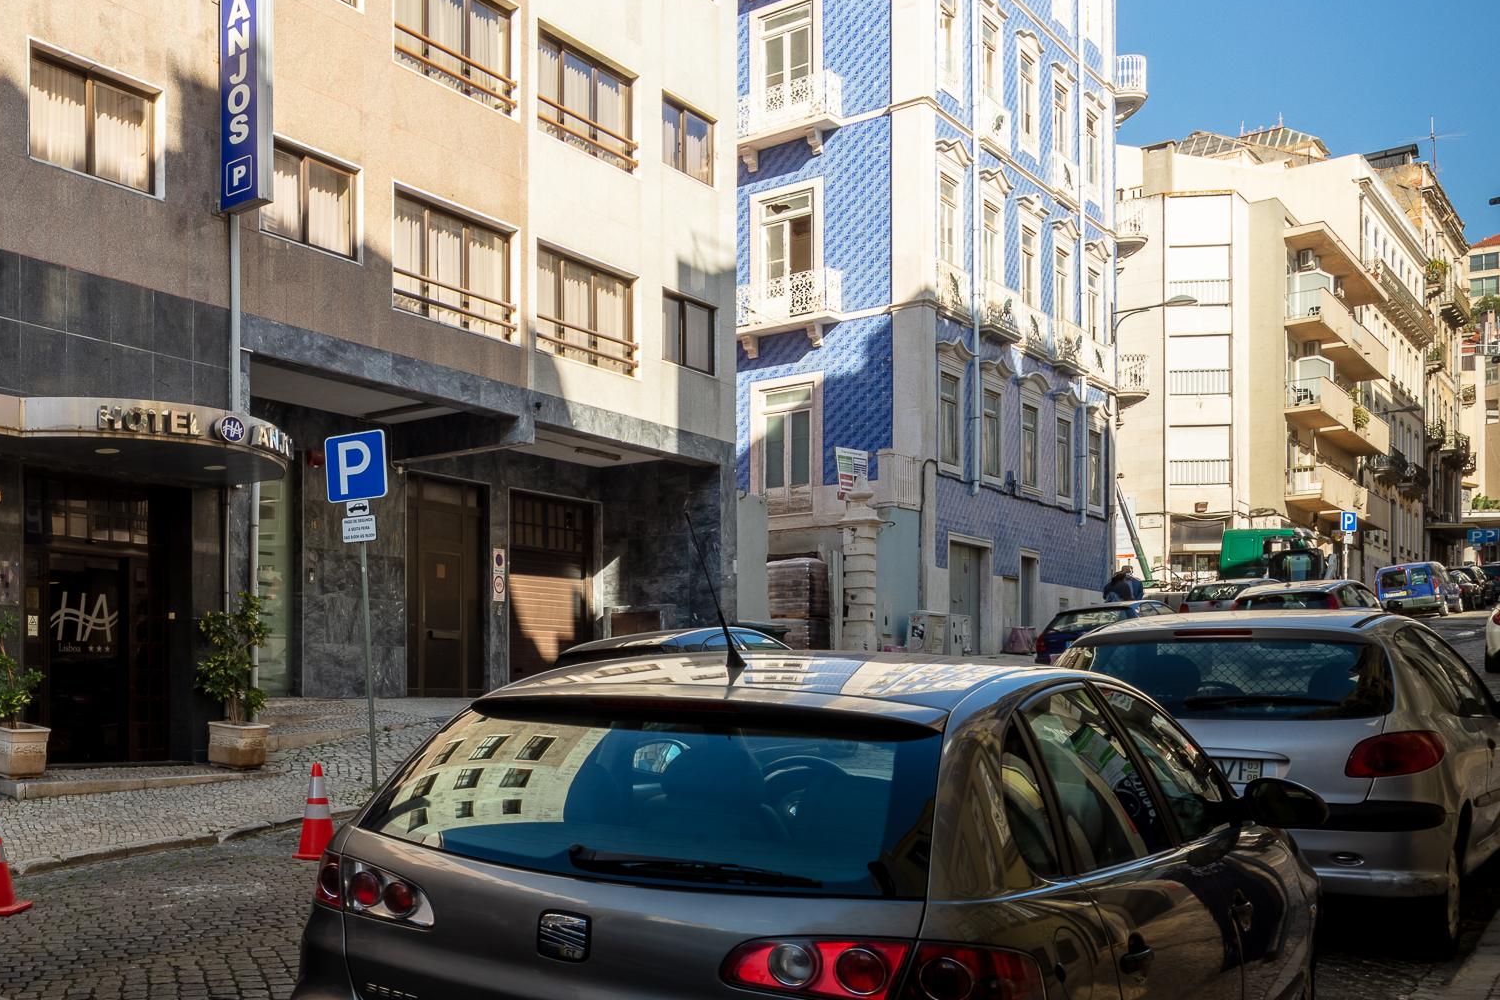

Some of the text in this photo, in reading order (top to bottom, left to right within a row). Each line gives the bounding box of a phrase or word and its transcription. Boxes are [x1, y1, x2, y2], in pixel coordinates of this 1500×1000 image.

[232, 165, 247, 187] P
[98, 405, 202, 436] HOTEL
[338, 440, 371, 495] P
[1344, 513, 1354, 530] P
[58, 642, 81, 653] Lisboa
